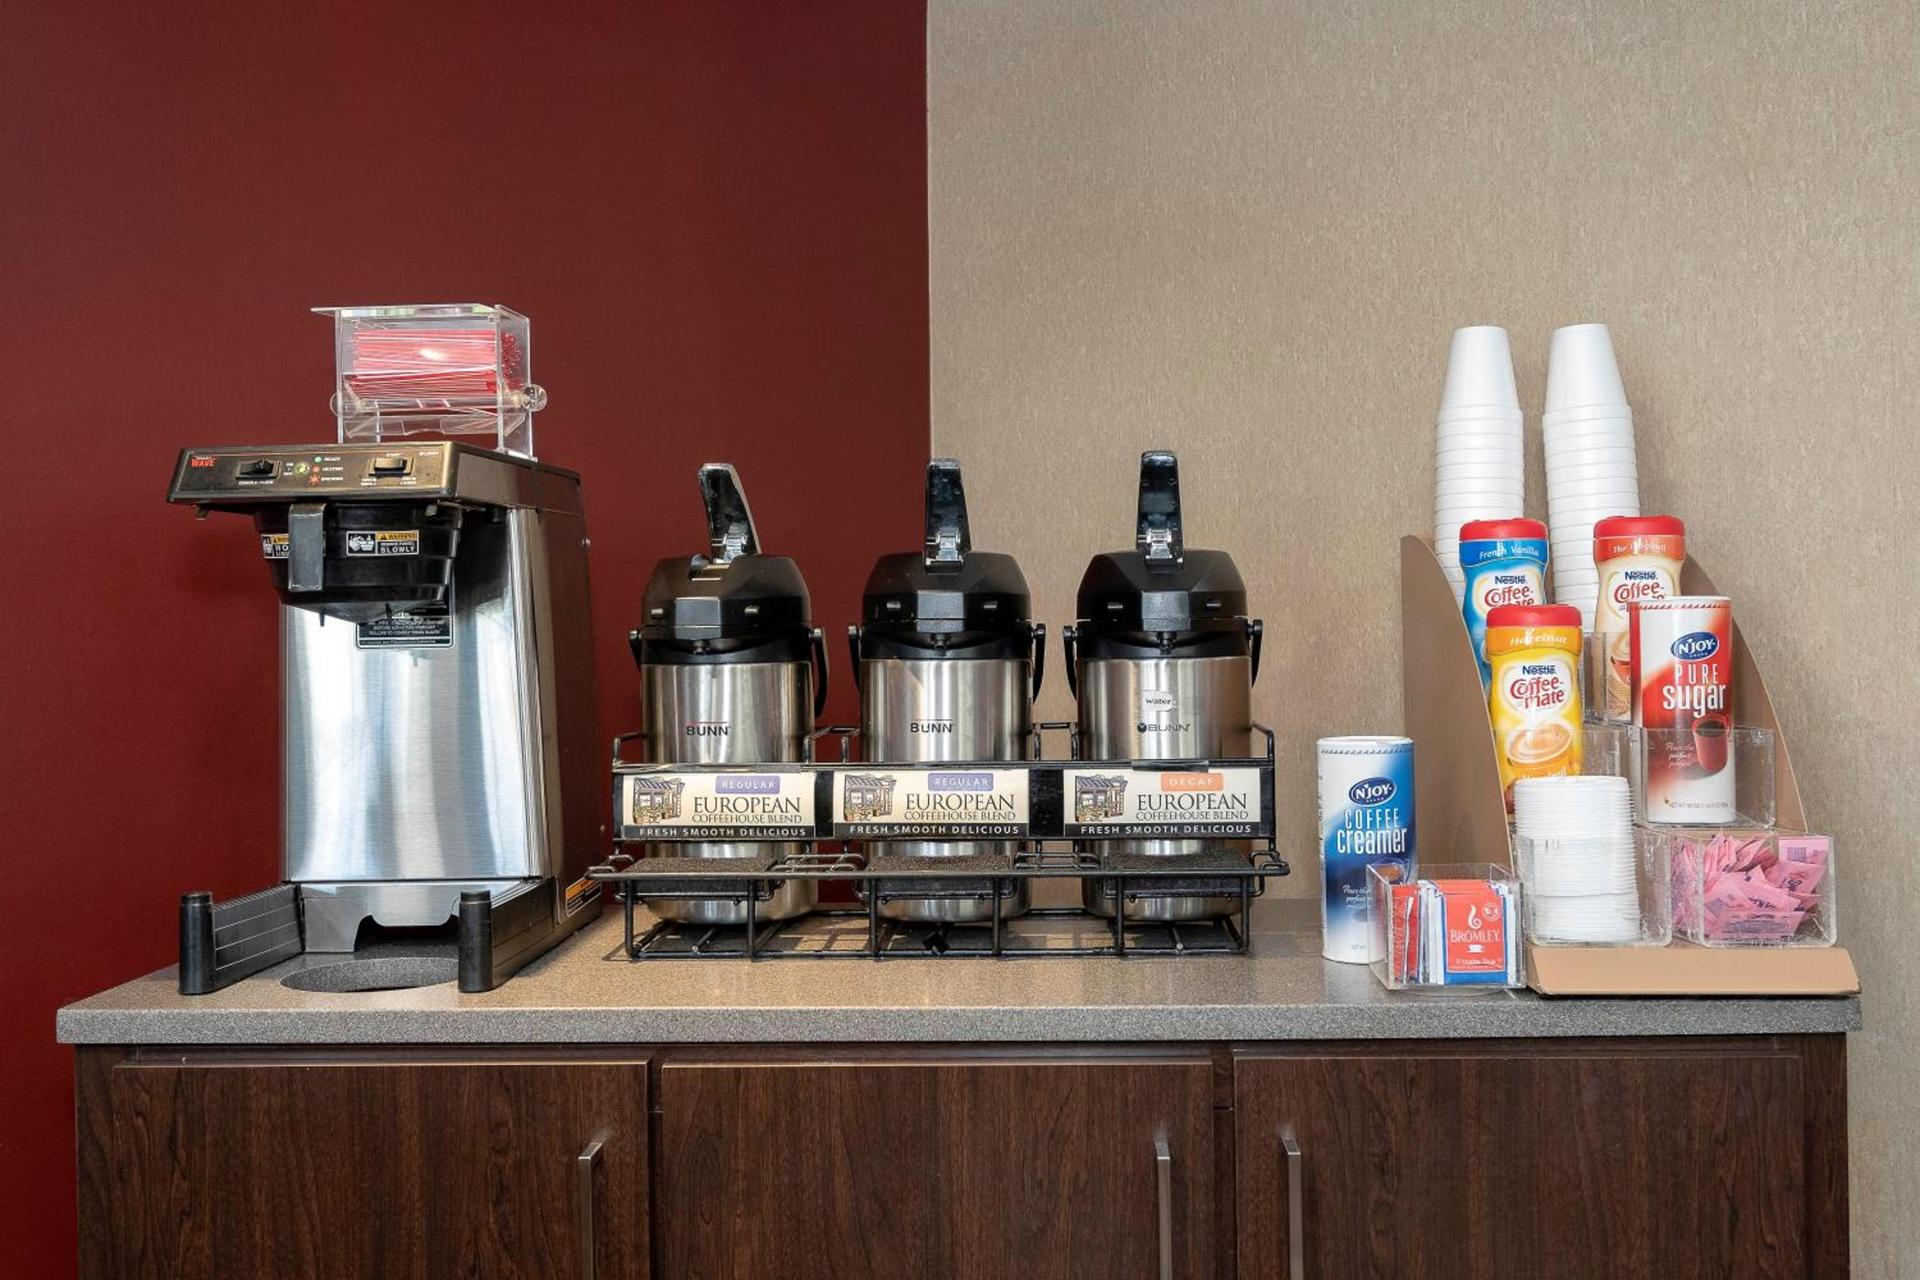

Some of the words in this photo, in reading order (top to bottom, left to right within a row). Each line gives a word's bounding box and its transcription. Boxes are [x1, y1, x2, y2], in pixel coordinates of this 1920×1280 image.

[191, 459, 216, 468] WAVE
[1511, 545, 1539, 556] Vanilla
[1510, 632, 1568, 645] Haelnut
[1675, 663, 1719, 684] PURE
[1146, 697, 1171, 705] water
[1662, 684, 1726, 718] sugar
[686, 726, 728, 736] BUNN
[910, 723, 952, 733] BUNN
[1148, 724, 1187, 732] BUNN
[721, 780, 775, 790] REGULAR
[935, 777, 988, 787] REGULAR
[1169, 778, 1214, 786] DECAF
[693, 796, 801, 814] EUROPEAN
[905, 793, 1015, 811] EUROPEAN
[1137, 793, 1247, 811] EUROPEAN
[692, 813, 766, 824] COFFEEHOUSE
[767, 814, 802, 824] BLEND
[904, 811, 978, 821] COFFEEHOUSE
[981, 810, 1016, 821] BLEND
[1136, 811, 1211, 821] COFFEEHOUSE
[1213, 810, 1249, 820] BLEND
[1345, 808, 1399, 830] COFFEE
[639, 827, 678, 836] FRESH
[682, 827, 735, 836] SMOOTH
[740, 827, 807, 836] DELICIOUS
[850, 825, 888, 834] FRESH
[894, 825, 946, 834] SMOOTH
[952, 825, 1020, 835] DELICIOUS
[1080, 826, 1120, 834] FRESH
[1125, 826, 1179, 834] SMOOTH
[1184, 825, 1252, 834] DELICIOUS
[1336, 828, 1408, 854] creamer
[1450, 928, 1500, 943] BROMLEY
